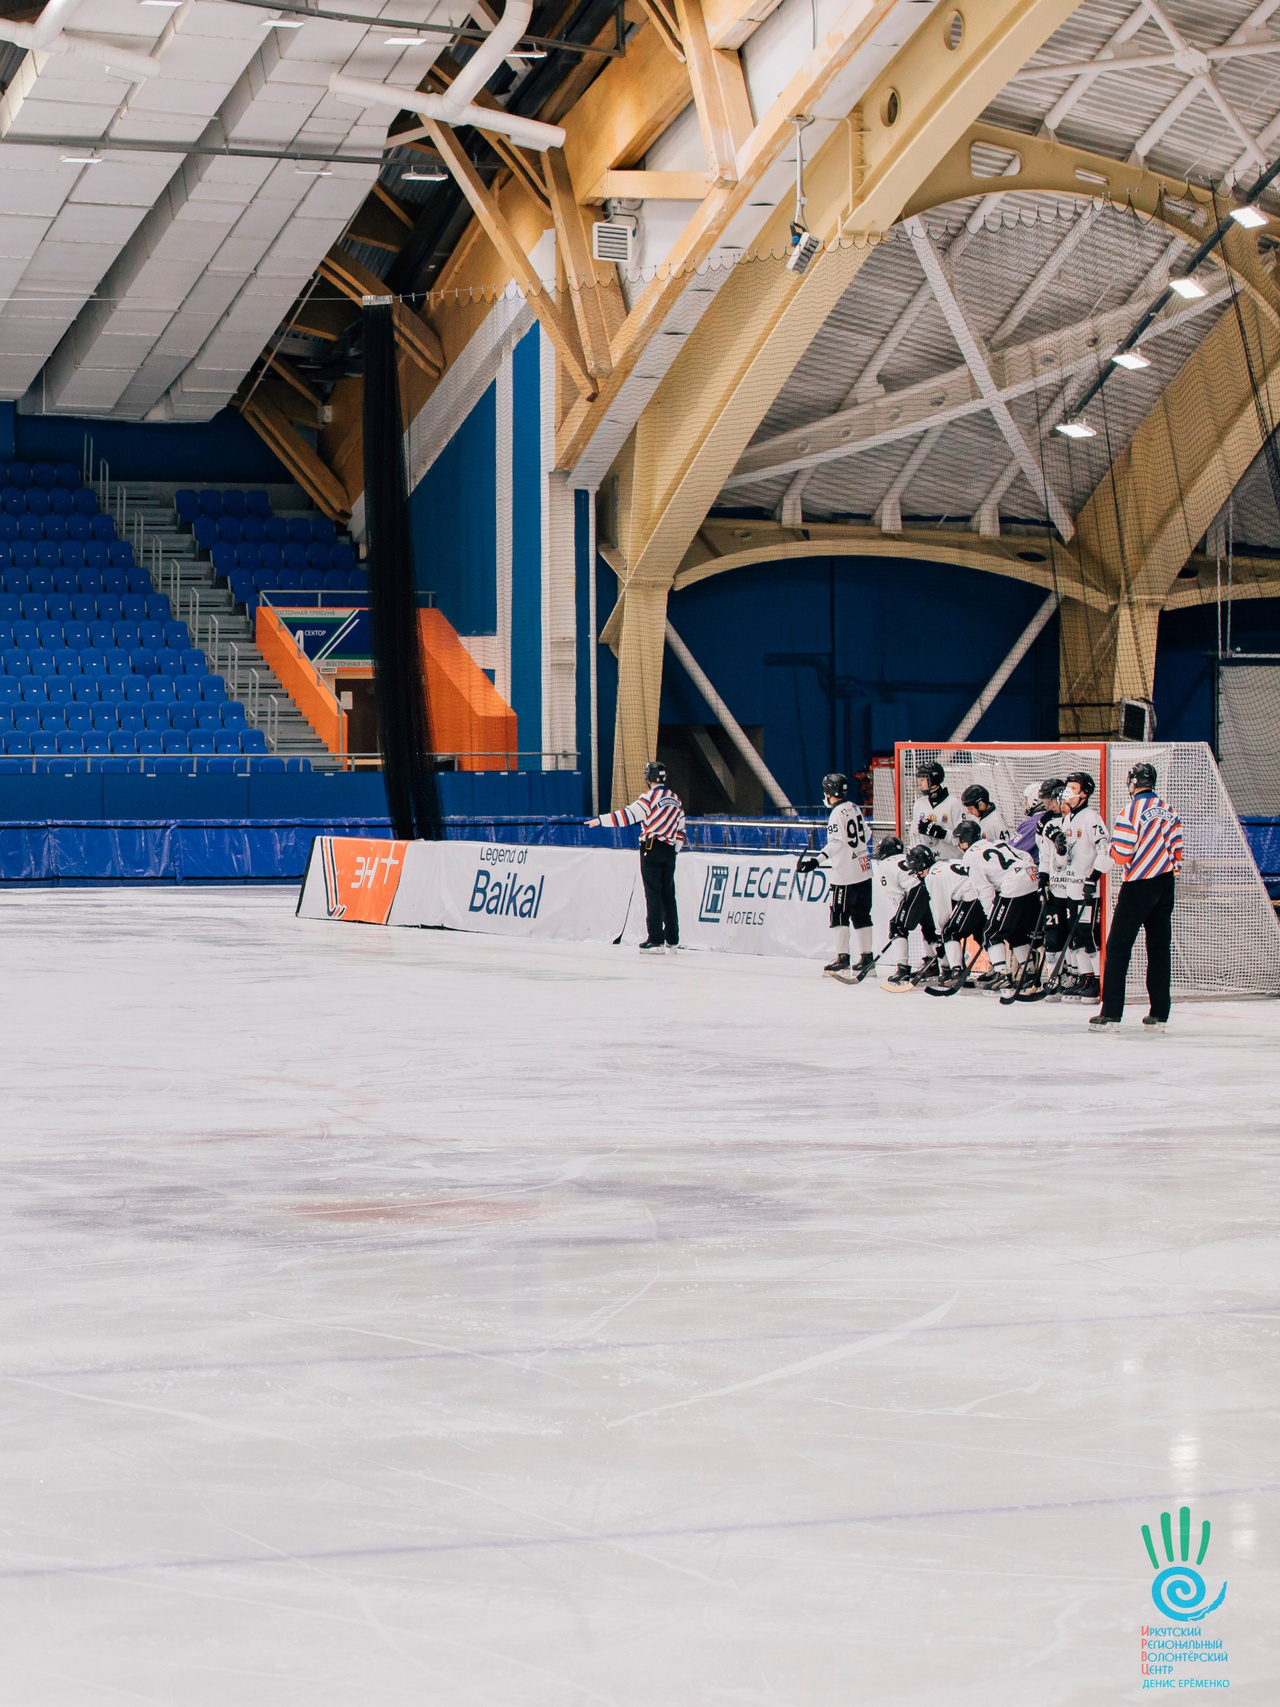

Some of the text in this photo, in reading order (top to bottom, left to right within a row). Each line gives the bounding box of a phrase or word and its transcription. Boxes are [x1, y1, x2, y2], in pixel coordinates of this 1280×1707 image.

[827, 824, 839, 834] 95
[846, 814, 867, 848] 95
[1092, 824, 1106, 836] 78
[479, 845, 529, 866] Legend of
[468, 868, 545, 919] Baikal
[726, 911, 765, 926] HOTELS
[1045, 913, 1060, 926] 21
